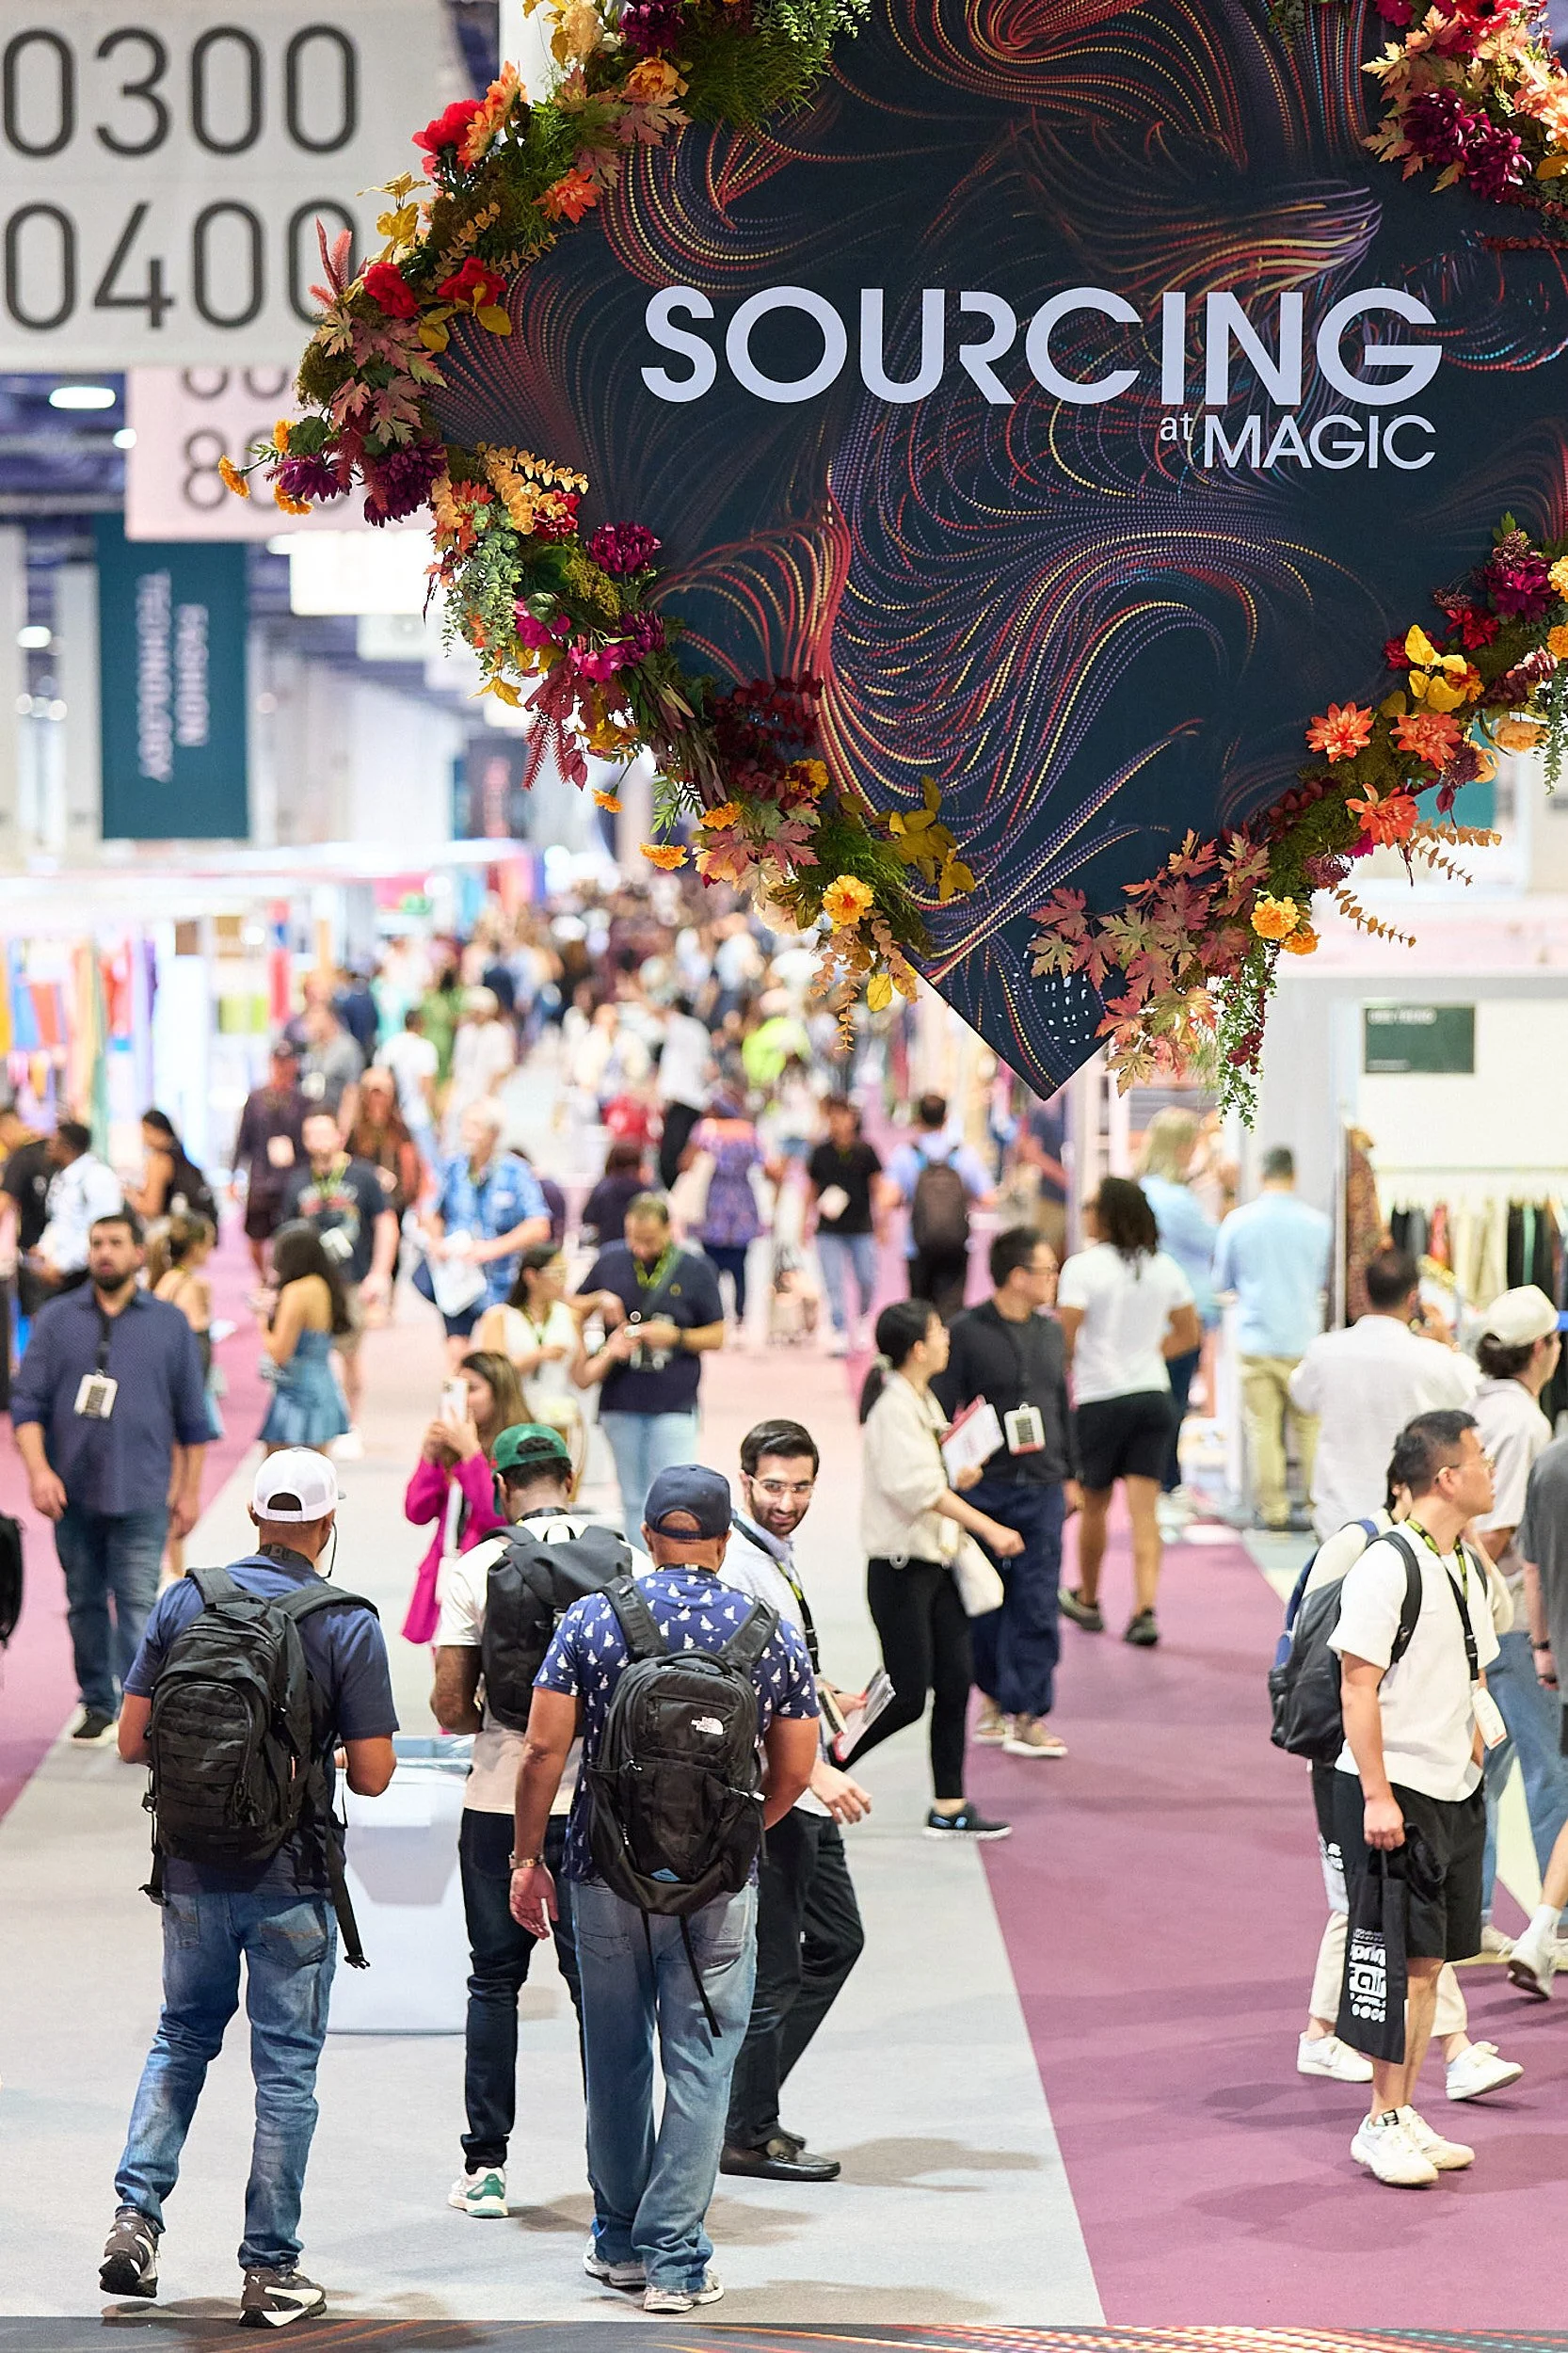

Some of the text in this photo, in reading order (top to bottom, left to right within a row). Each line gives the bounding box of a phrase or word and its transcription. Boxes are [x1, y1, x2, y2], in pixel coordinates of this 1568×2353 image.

[1, 23, 360, 159] 0300
[3, 199, 358, 330] 0400
[640, 284, 1444, 406] SOURCING
[1159, 411, 1437, 470] at MAGIC
